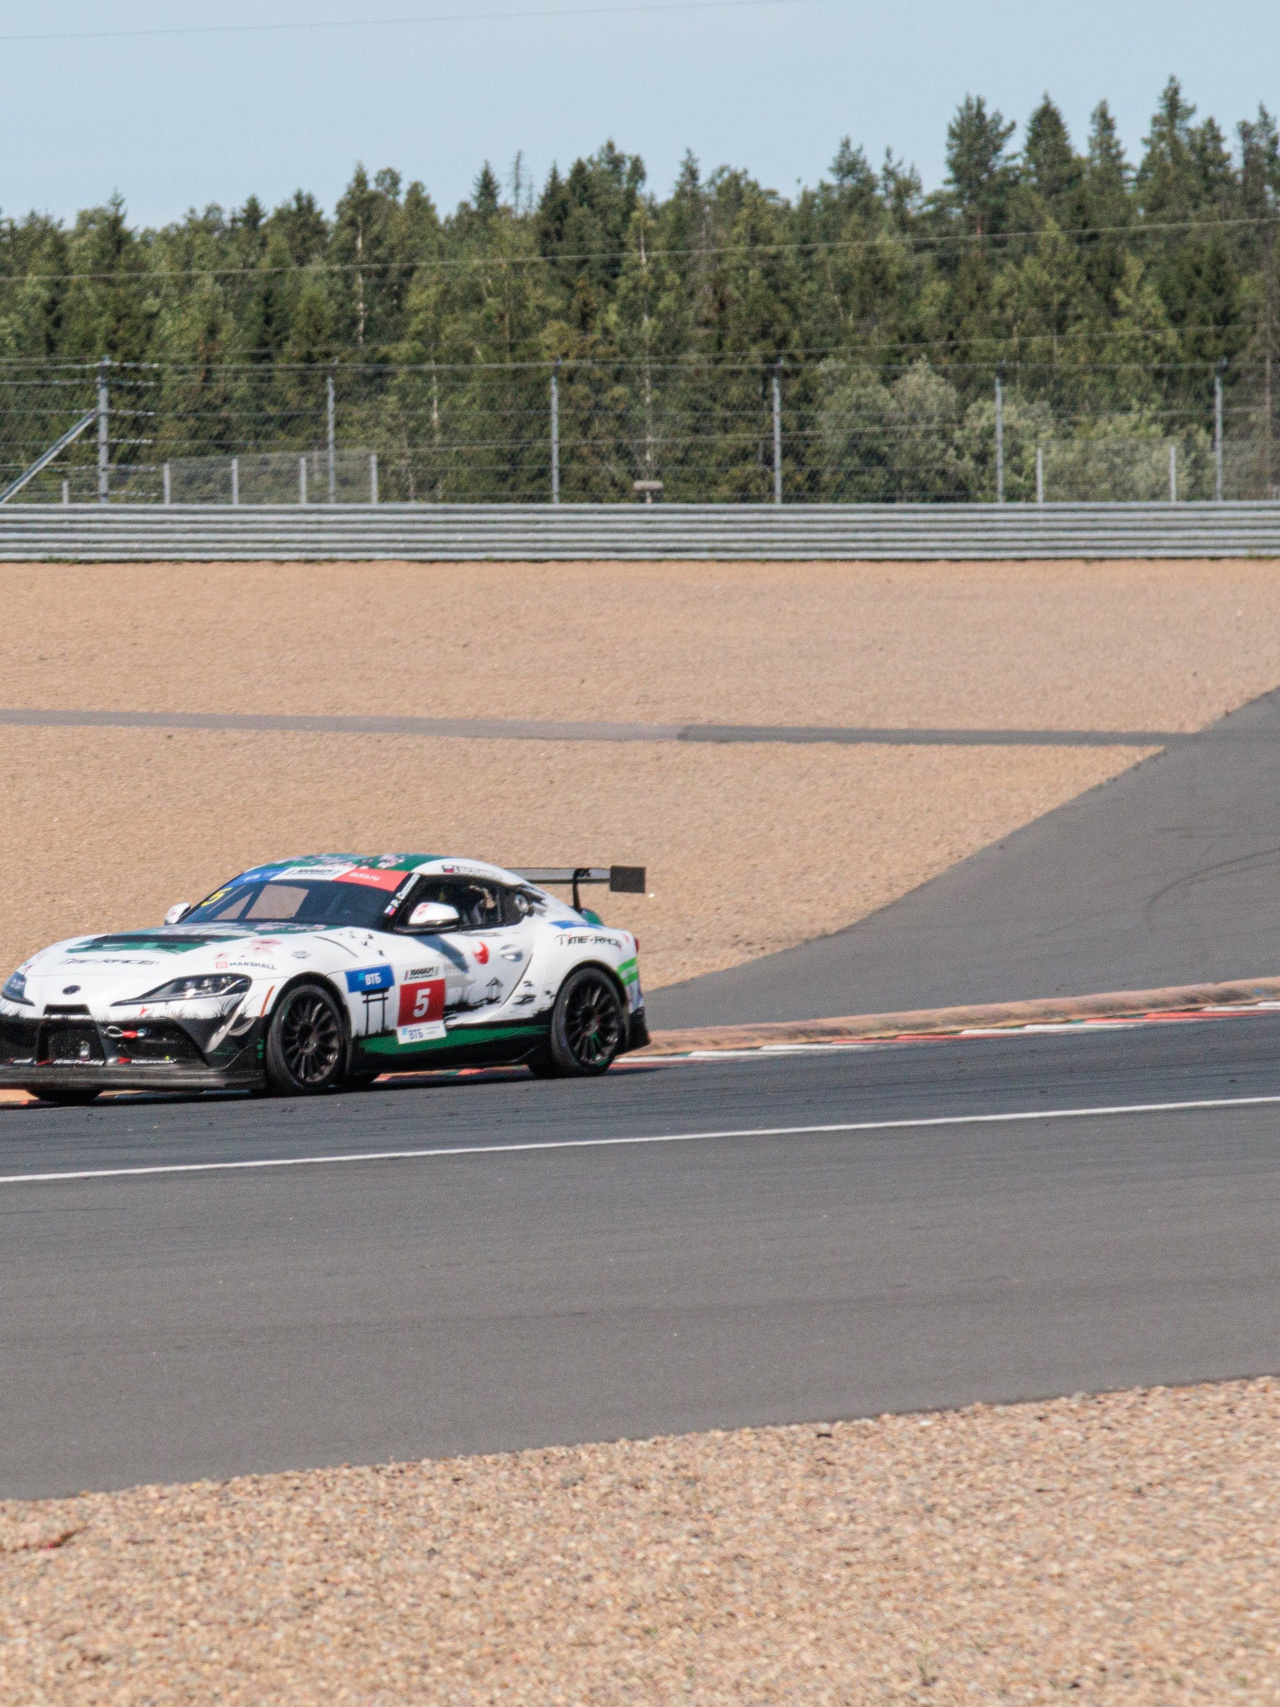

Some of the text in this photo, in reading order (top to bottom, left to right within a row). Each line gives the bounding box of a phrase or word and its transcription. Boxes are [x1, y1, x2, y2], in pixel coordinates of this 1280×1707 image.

[349, 871, 381, 882] auto.ru
[229, 961, 276, 970] MARSHALL
[365, 972, 382, 986] ВТБ
[413, 987, 431, 1017] 5
